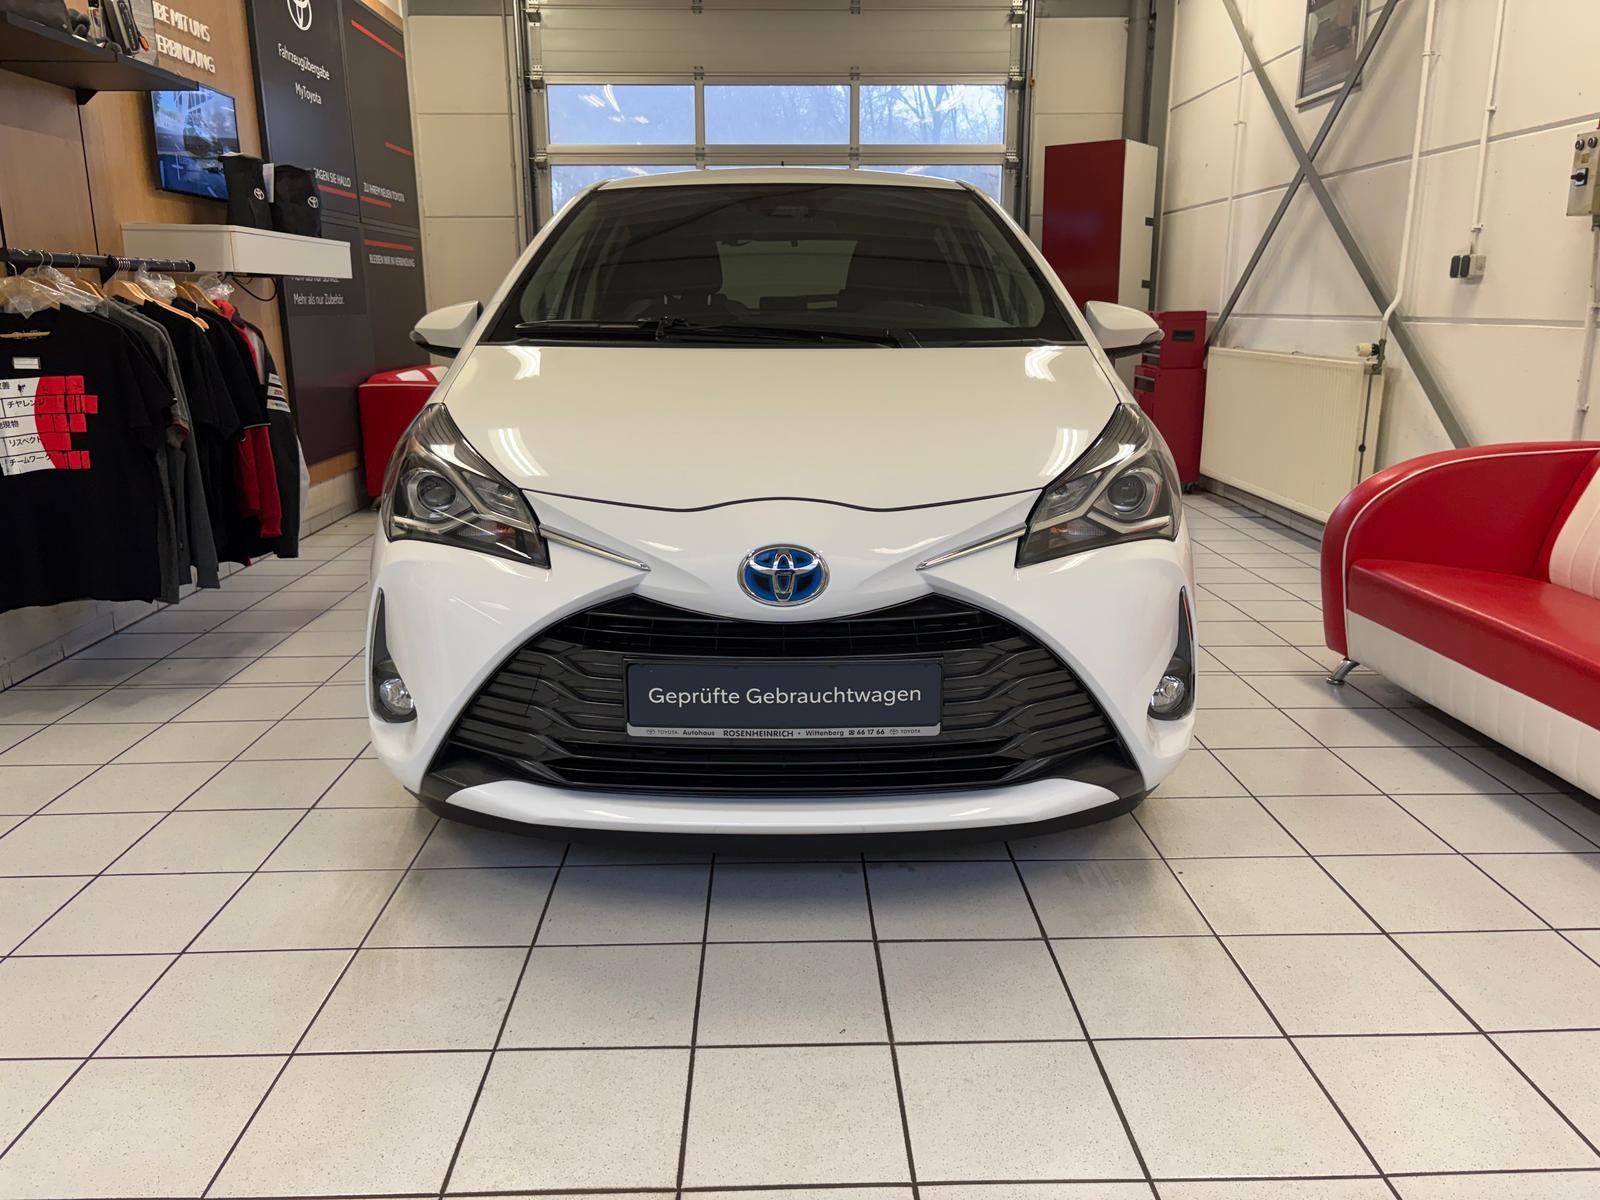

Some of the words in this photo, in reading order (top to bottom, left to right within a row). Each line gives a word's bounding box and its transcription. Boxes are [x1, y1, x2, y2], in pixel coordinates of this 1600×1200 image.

[170, 8, 188, 32] MIT
[188, 18, 210, 42] UNS
[278, 42, 330, 80] Fahrzeugübergabe
[295, 81, 322, 104] MyToyota
[293, 292, 307, 305] Mehr
[308, 293, 316, 305] als
[316, 296, 324, 305] nur
[648, 687, 740, 708] Geprüfte
[746, 686, 922, 706] Gebrauchtwagen
[682, 729, 715, 737] Autohaus
[723, 729, 794, 737] ROSENHEINRICH
[805, 729, 844, 737] Wittenberg
